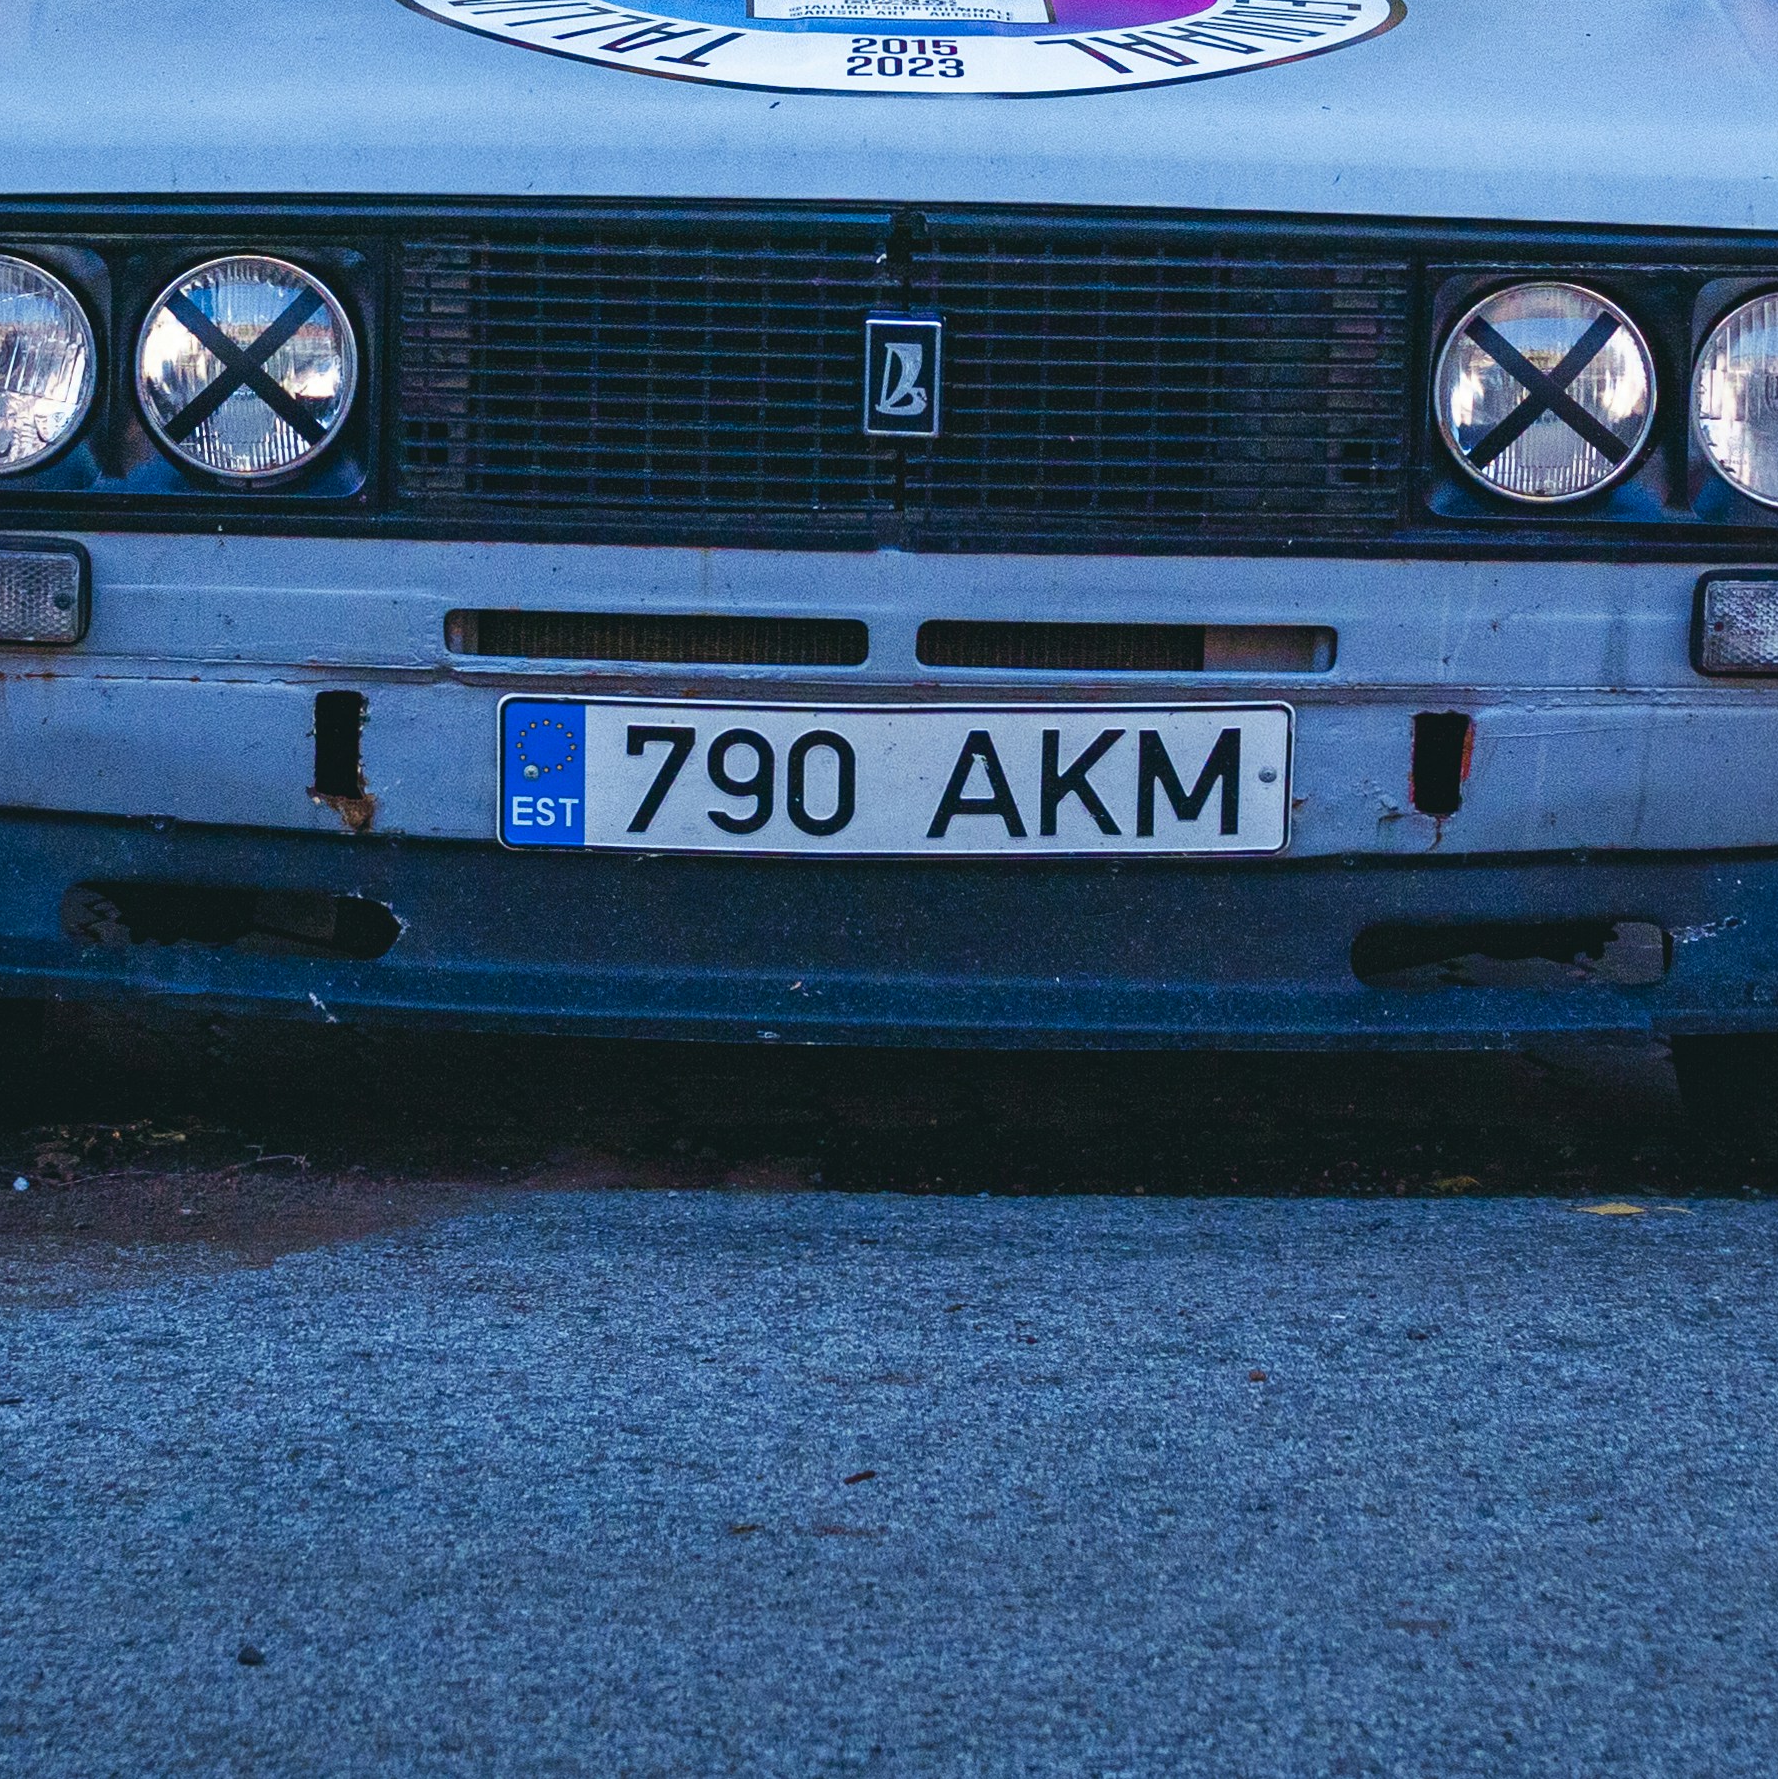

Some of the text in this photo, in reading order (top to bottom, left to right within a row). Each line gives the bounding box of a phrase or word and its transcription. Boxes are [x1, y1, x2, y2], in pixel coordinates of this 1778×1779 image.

[851, 38, 958, 56] 2015
[846, 56, 965, 79] 2023
[626, 725, 1241, 837] 790 AKM
[511, 796, 579, 828] EST
